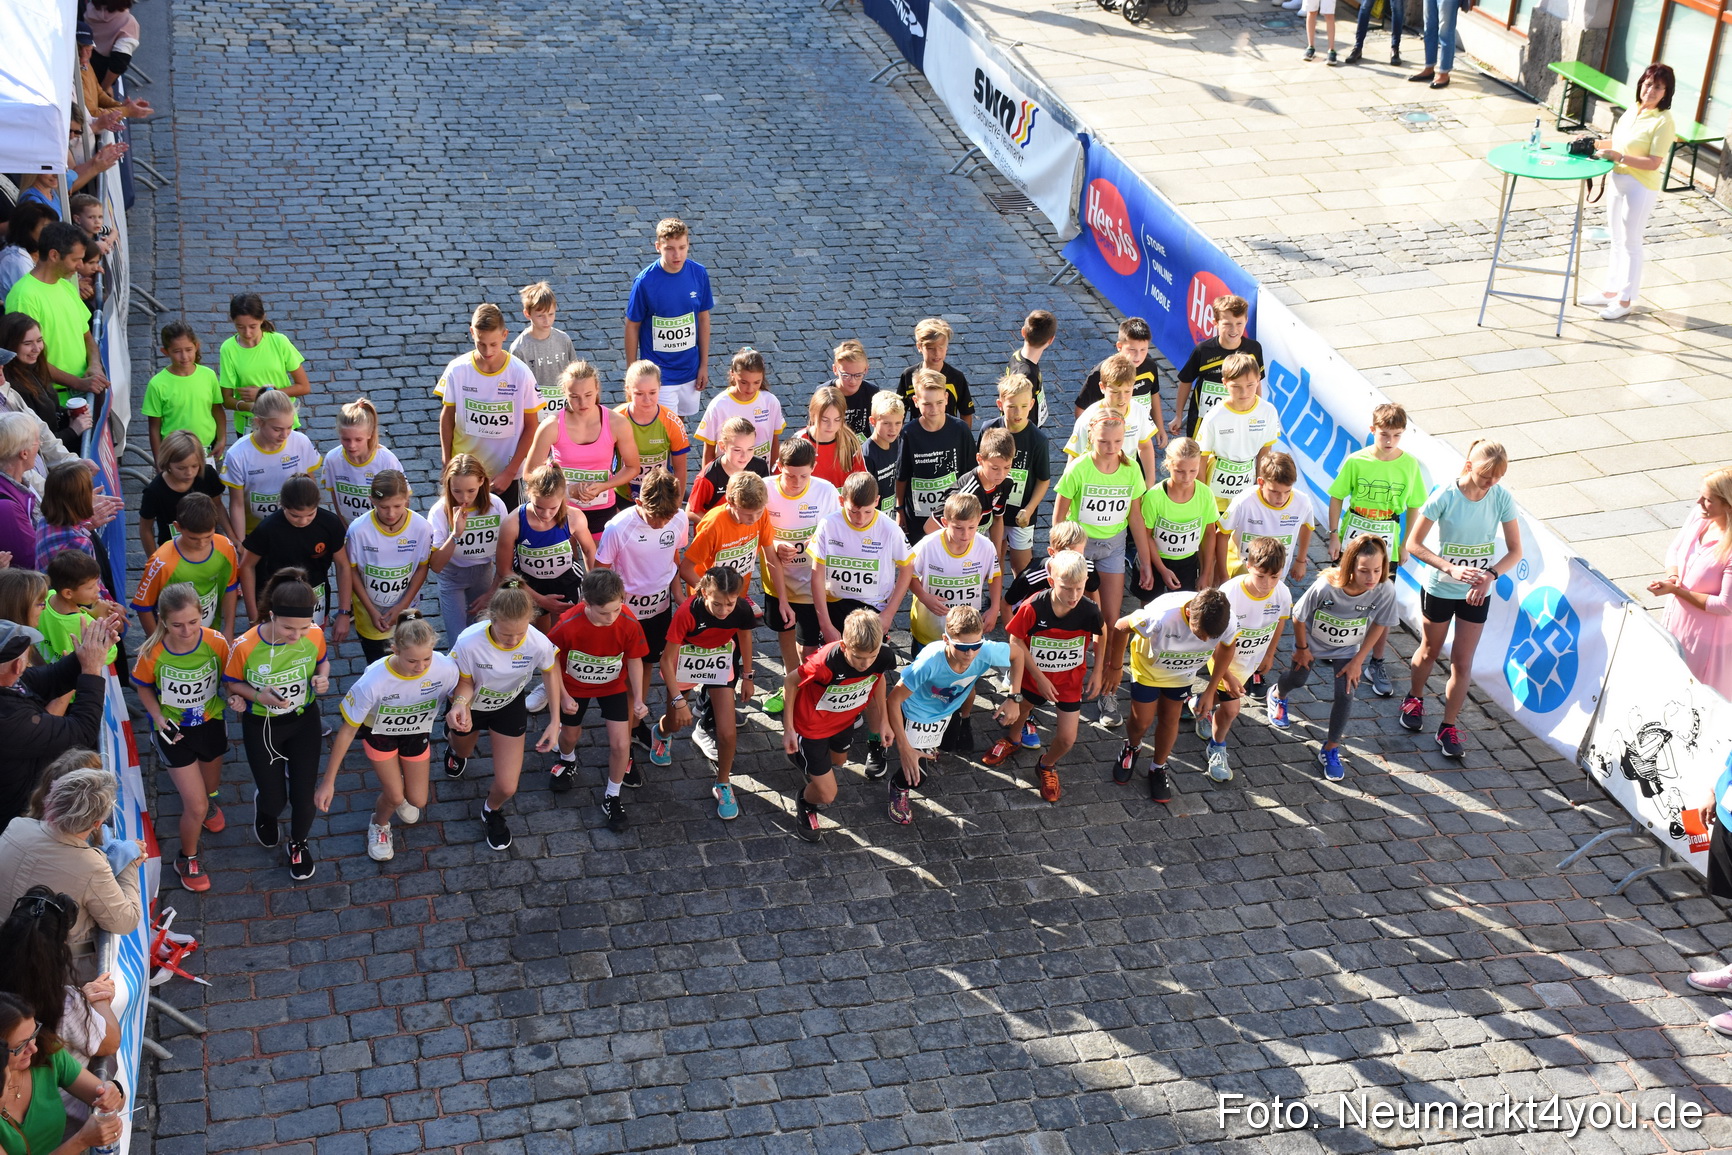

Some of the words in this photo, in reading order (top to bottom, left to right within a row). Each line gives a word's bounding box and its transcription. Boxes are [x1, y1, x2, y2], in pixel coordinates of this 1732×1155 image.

[974, 67, 1016, 136] swn
[1087, 184, 1138, 262] Hervis
[1146, 234, 1167, 257] STORE
[1152, 259, 1173, 286] ONLINE
[1151, 284, 1171, 312] MOBILE
[655, 315, 692, 327] BOCK
[657, 327, 691, 341] 4003
[468, 400, 510, 412] BOCK
[470, 413, 509, 426] 4049
[639, 453, 664, 463] OCK
[1219, 458, 1252, 473] BOCK
[565, 470, 605, 481] BOCK
[1216, 473, 1250, 486] 4024
[915, 479, 952, 489] BOCK
[918, 491, 945, 504] 402
[1087, 485, 1129, 497] BOCK
[257, 504, 278, 513] 40
[343, 495, 375, 510] 404
[1086, 499, 1126, 512] 4010
[466, 516, 496, 528] OCK
[1159, 519, 1200, 533] BOCK
[1351, 518, 1390, 531] BOCK
[1159, 531, 1196, 545] 4011
[519, 543, 566, 556] BOCK
[720, 541, 757, 560] BOCK
[1447, 544, 1492, 555] BOCK
[524, 556, 566, 568] 4013
[830, 557, 875, 569] BOCK
[366, 563, 412, 578] BOCK
[831, 569, 873, 585] 4016
[370, 577, 409, 593] 4048
[932, 576, 976, 587] BOCK
[841, 585, 862, 593] LEON
[934, 588, 975, 601] 4015
[628, 589, 667, 607] 4022
[202, 601, 214, 620] 51
[1318, 613, 1364, 627] BOCK
[1318, 623, 1360, 637] 4001
[1036, 638, 1079, 648] BOCK
[572, 654, 618, 665] BOCK
[1035, 649, 1078, 661] 4045
[572, 663, 616, 674] 4025
[683, 656, 726, 670] 4046
[1036, 661, 1078, 669] JONATHAN
[1162, 658, 1205, 666] 4005
[165, 663, 214, 680] BOCK
[252, 668, 302, 685] BOCK
[167, 676, 212, 696] 4027
[831, 678, 874, 693] BOCK
[177, 695, 206, 704] MARIE
[827, 688, 869, 703] 4044
[383, 702, 433, 714] BOCK
[382, 712, 429, 725] 4007
